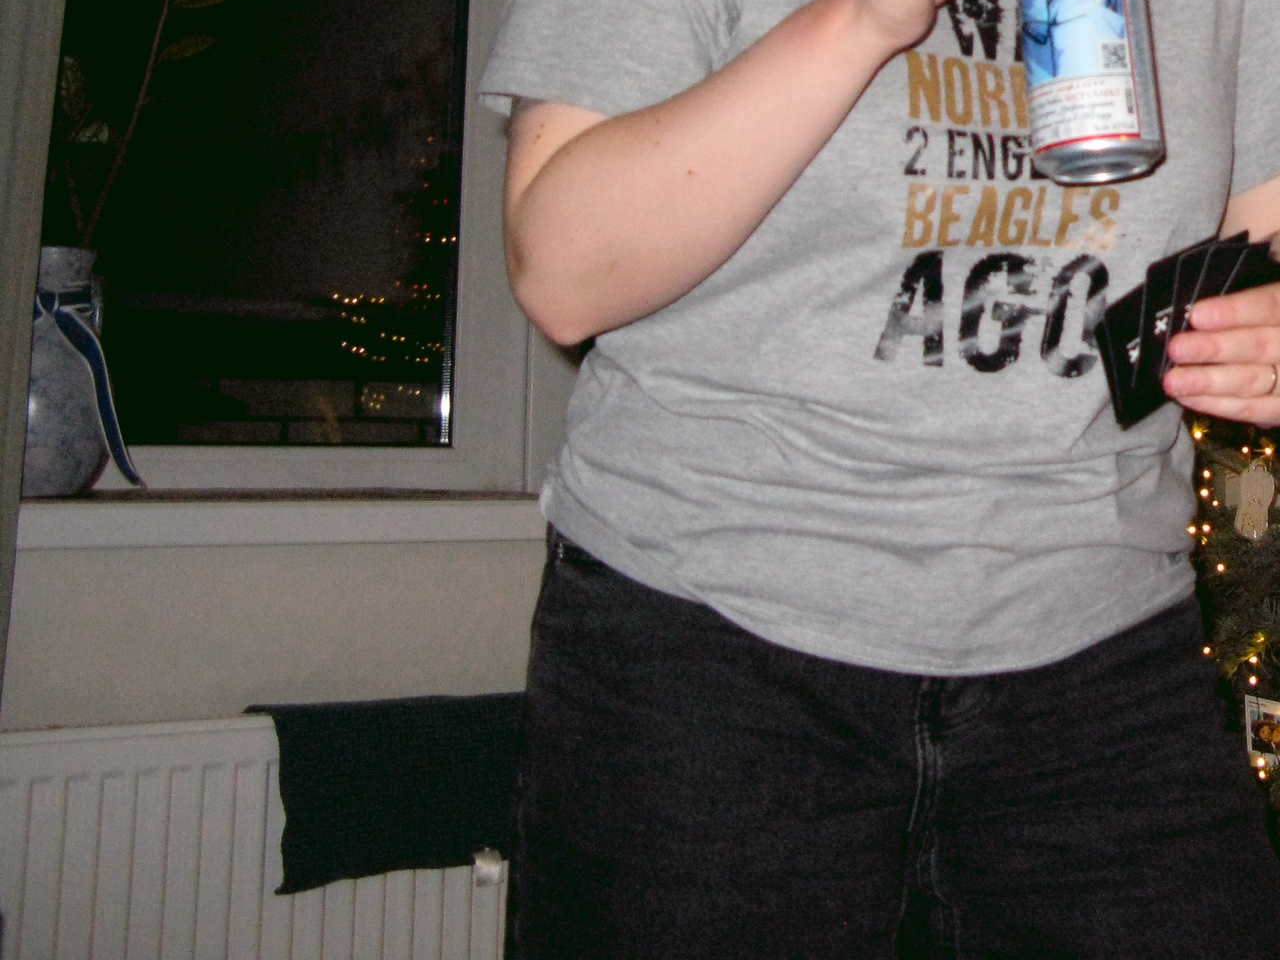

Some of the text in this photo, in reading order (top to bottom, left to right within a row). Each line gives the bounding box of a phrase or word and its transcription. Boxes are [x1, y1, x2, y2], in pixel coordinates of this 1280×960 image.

[904, 126, 928, 175] 2
[902, 182, 1120, 251] BEAGLES
[873, 250, 1110, 378] AGO
